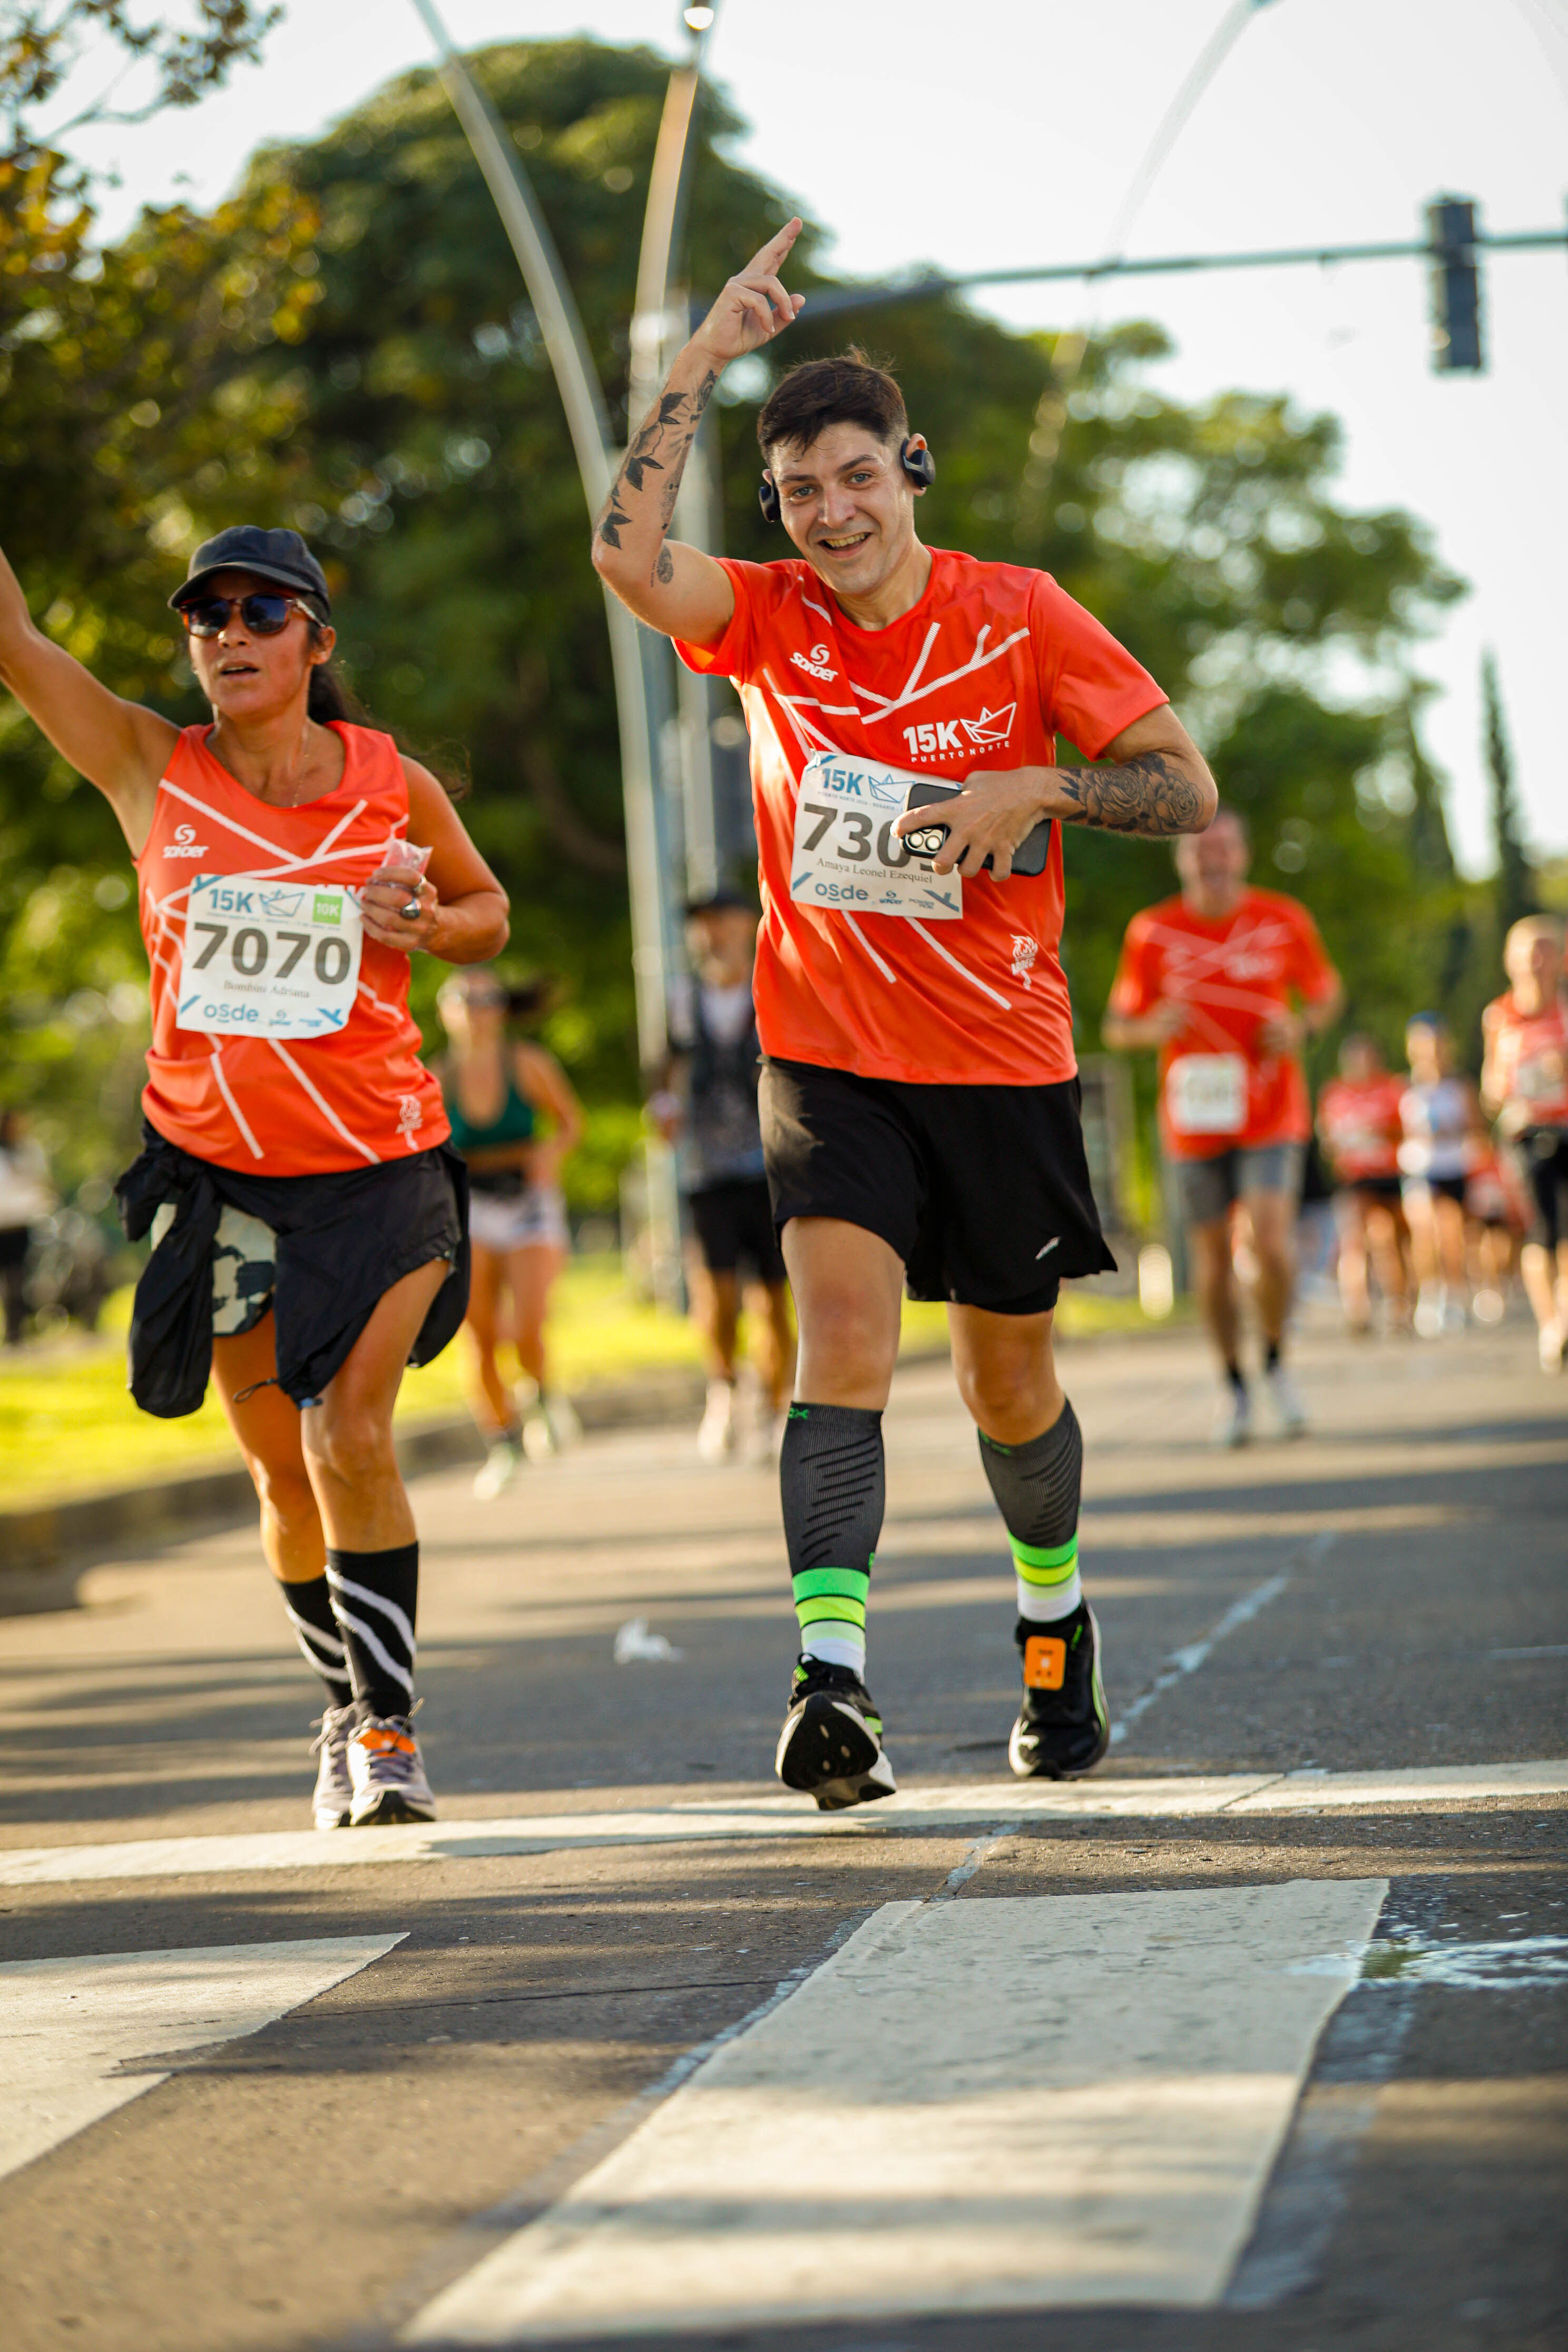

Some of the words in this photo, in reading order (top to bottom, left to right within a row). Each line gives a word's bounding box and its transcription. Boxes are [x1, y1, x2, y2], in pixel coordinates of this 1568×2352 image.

[903, 720, 963, 754] 15K
[911, 750, 964, 762] PUERTO
[969, 741, 1010, 756] NORTE
[821, 768, 864, 796] 15K
[802, 803, 935, 873] 730
[817, 858, 850, 873] Amaya
[853, 865, 886, 877] Leonel
[890, 870, 933, 883] Ezequiel
[210, 889, 255, 913] 15K
[317, 902, 340, 917] 10K
[815, 883, 869, 901] osde
[192, 922, 351, 985] 7070
[204, 1003, 259, 1023] osde
